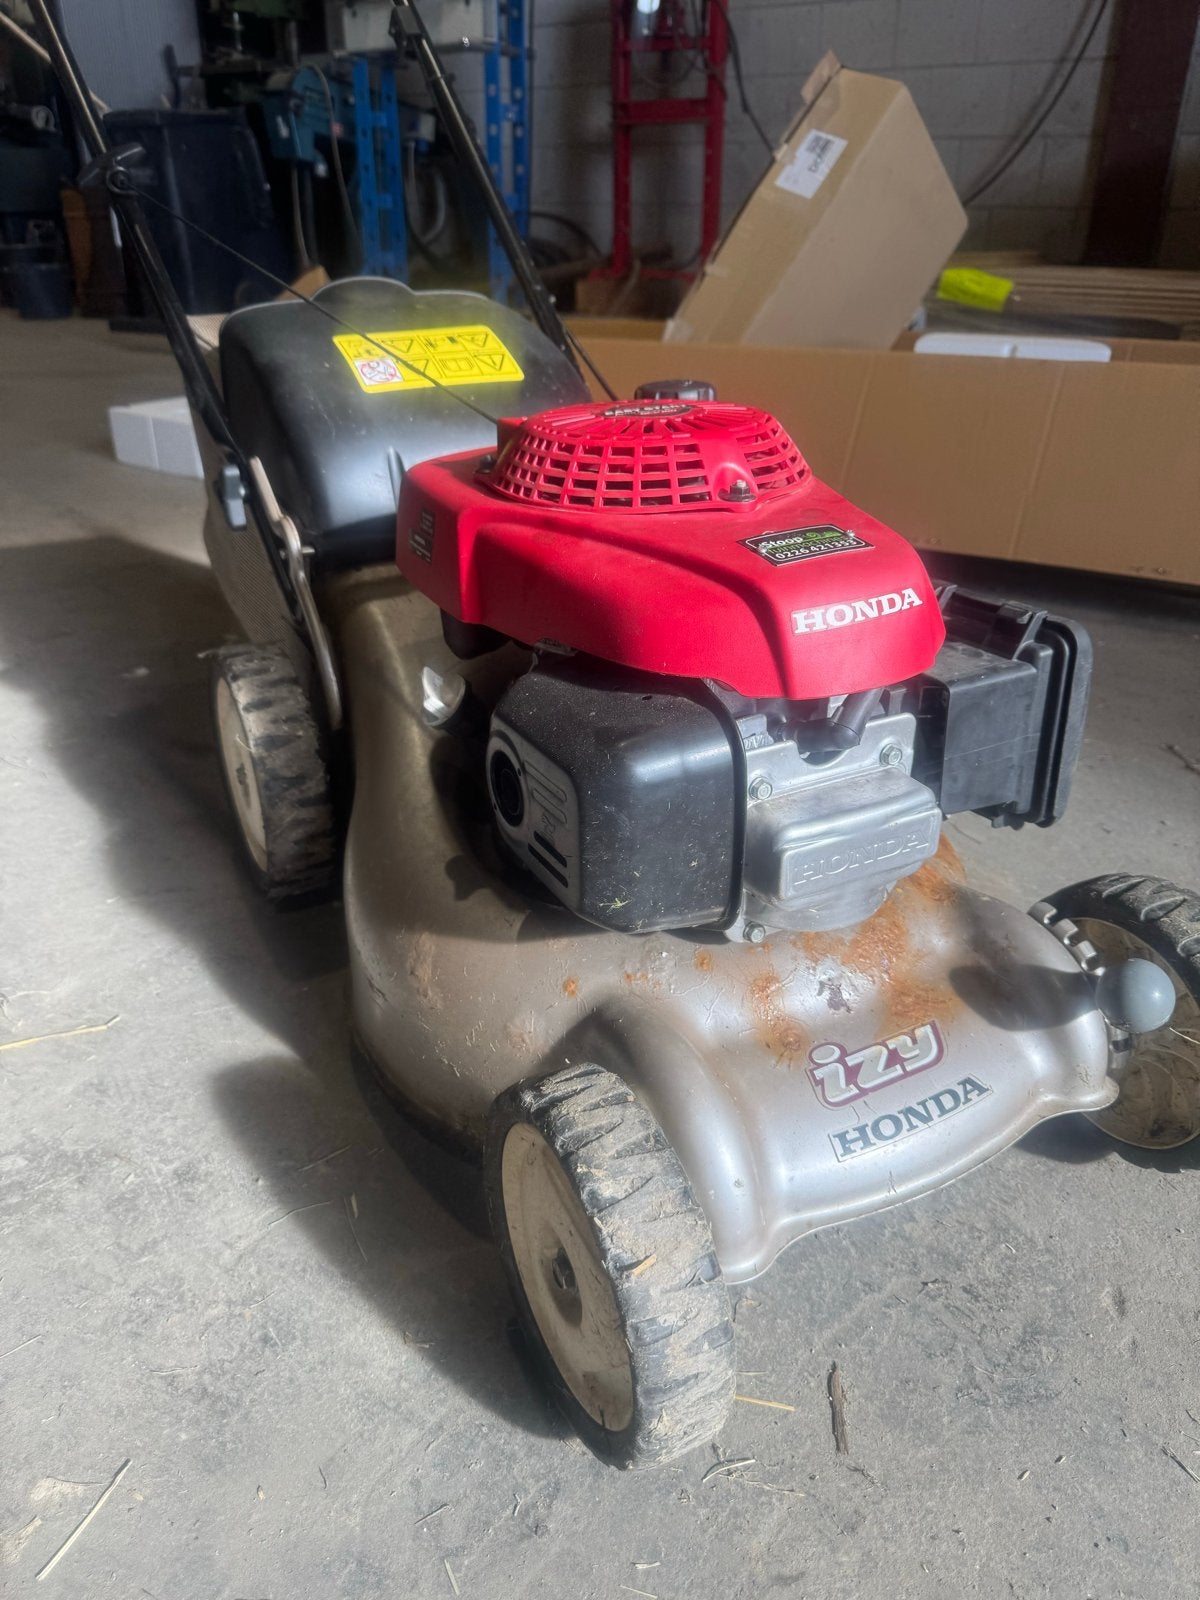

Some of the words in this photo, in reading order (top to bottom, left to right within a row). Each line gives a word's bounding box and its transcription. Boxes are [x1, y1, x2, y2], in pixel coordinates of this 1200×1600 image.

[760, 536, 804, 549] Stoop
[775, 547, 810, 559] 0226
[792, 587, 923, 634] HONDA
[793, 830, 930, 886] HONDA
[809, 1021, 943, 1107] izy
[832, 1076, 990, 1158] HONDA
